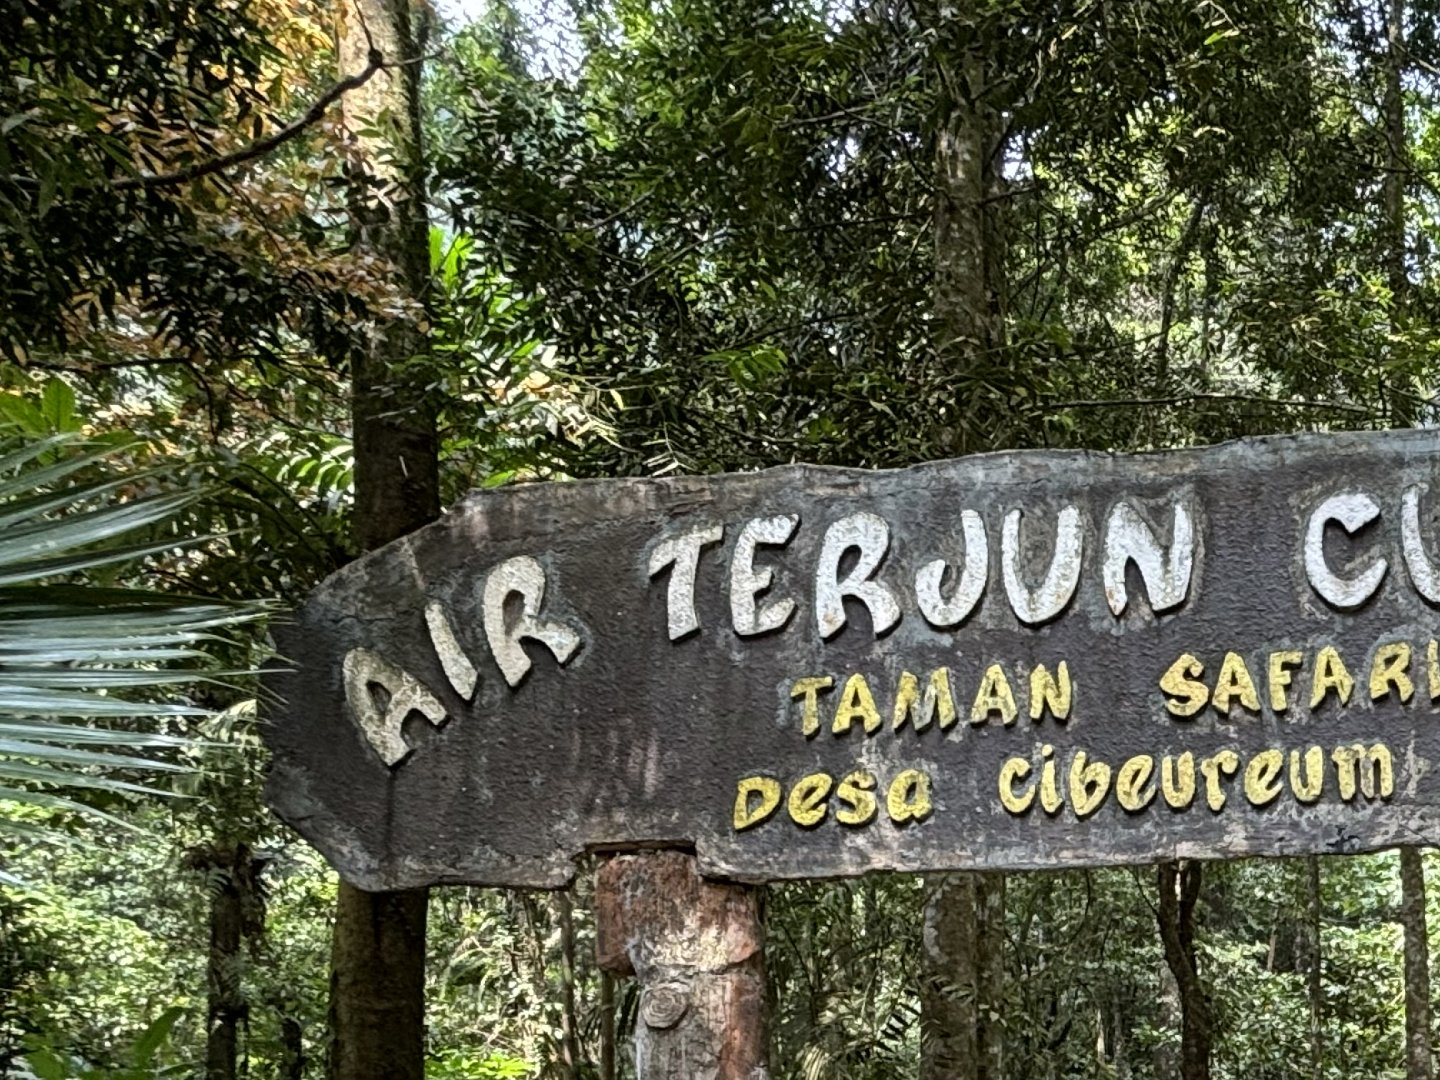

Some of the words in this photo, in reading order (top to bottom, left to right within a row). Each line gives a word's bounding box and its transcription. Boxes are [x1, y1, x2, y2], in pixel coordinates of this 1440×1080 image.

[342, 555, 581, 766] AIR
[649, 497, 1193, 642] TERJUN
[791, 660, 1072, 737] TAMAN
